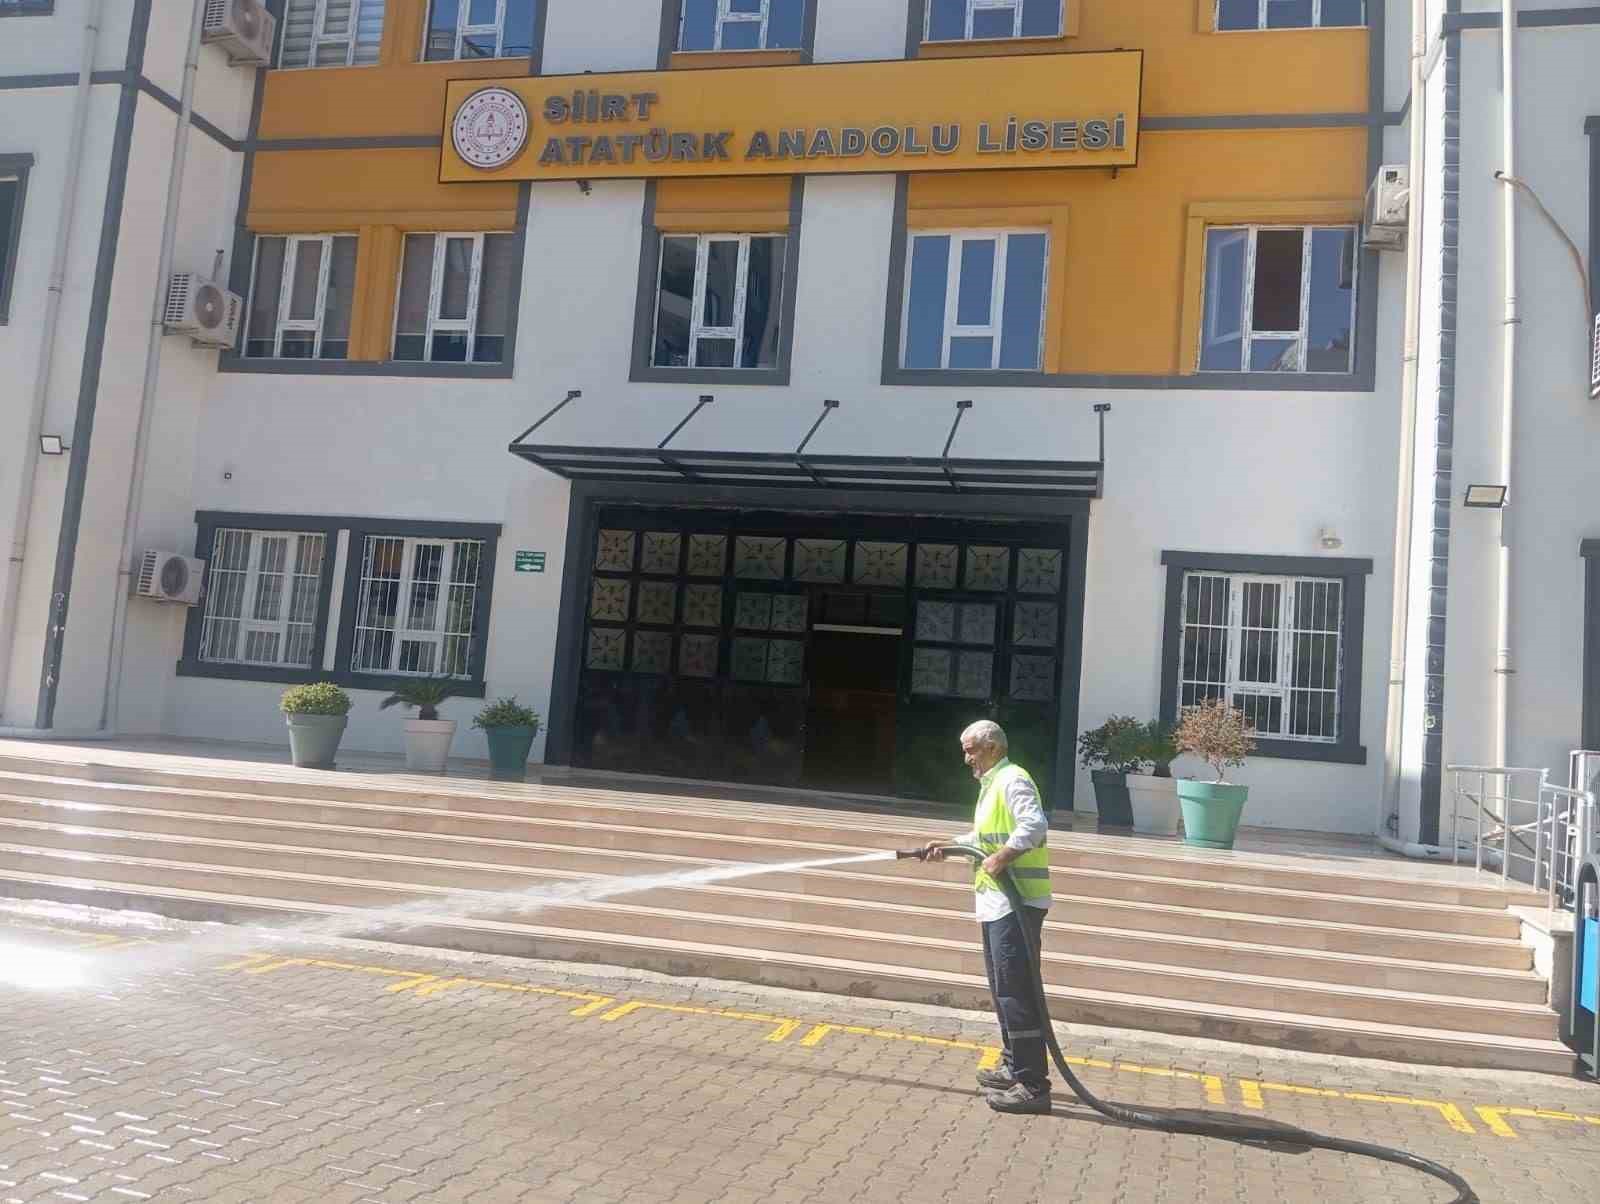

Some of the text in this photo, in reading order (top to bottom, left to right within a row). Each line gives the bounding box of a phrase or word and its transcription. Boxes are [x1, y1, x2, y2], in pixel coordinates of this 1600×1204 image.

[543, 89, 659, 124] SİİRT
[538, 127, 735, 168] ATATÜRK
[744, 124, 961, 161] ANADOLU
[976, 113, 1127, 153] LİSESİ
